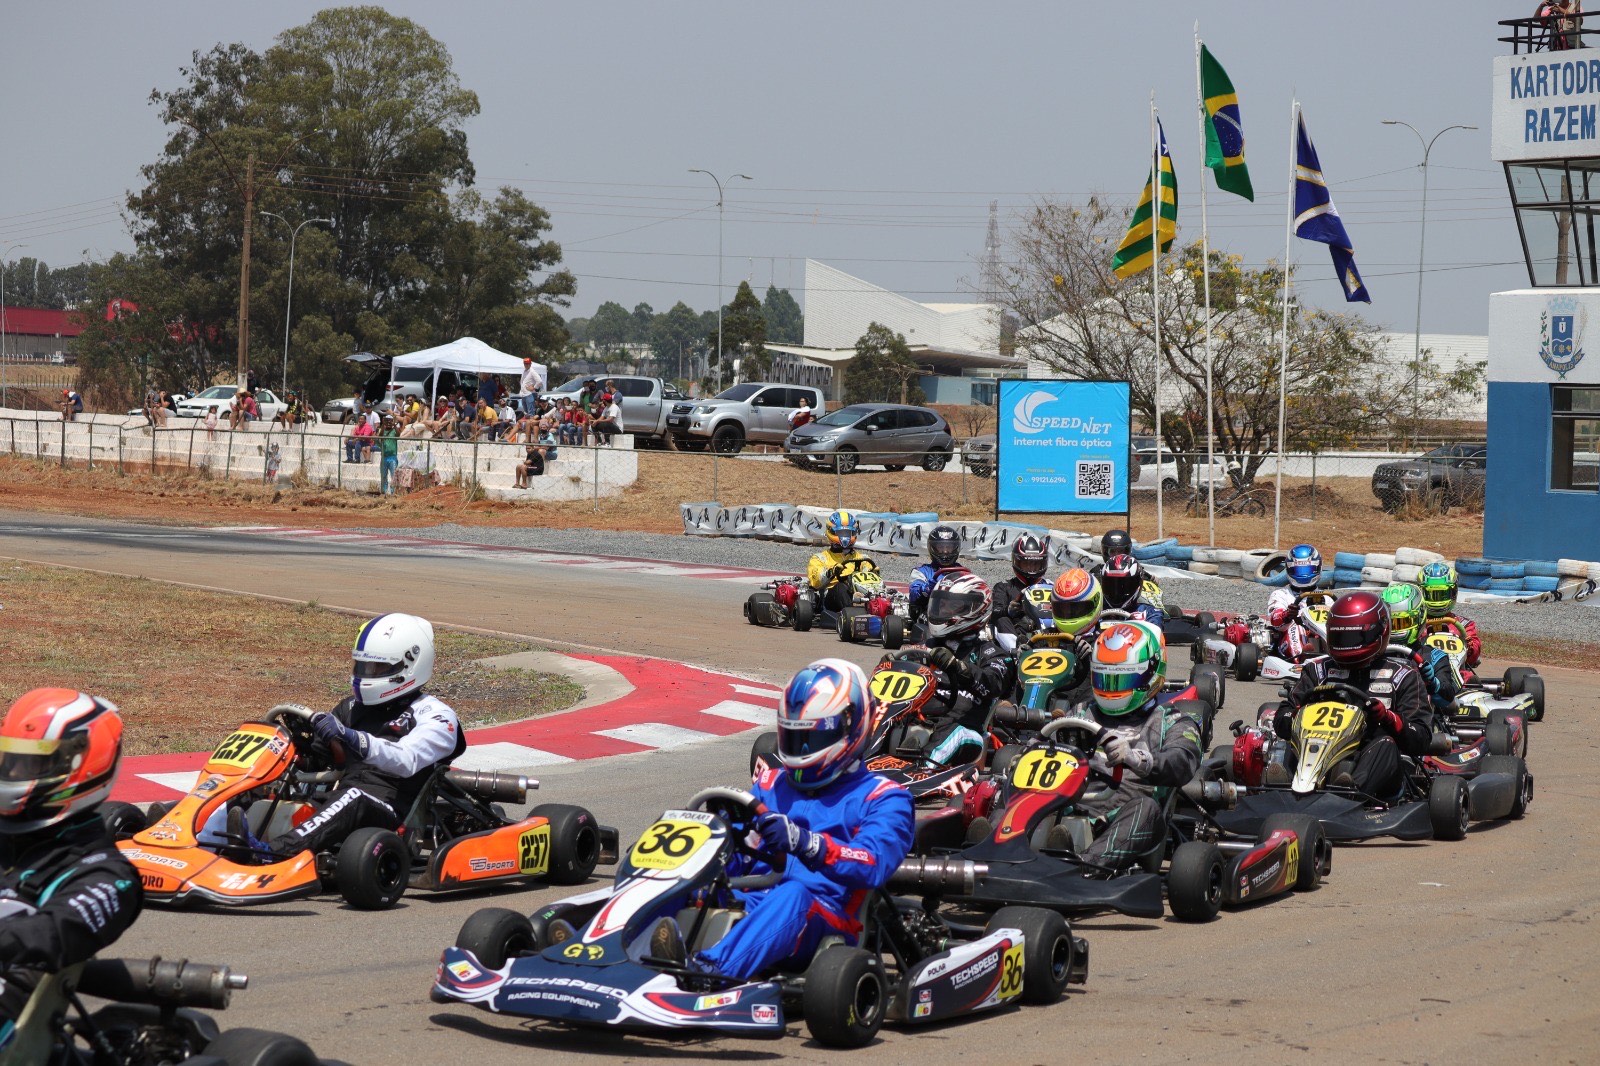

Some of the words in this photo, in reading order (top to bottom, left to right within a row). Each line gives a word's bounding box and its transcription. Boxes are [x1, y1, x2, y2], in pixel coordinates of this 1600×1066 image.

[1525, 105, 1596, 143] RAZEM
[1031, 416, 1082, 429] SPEED
[1013, 437, 1053, 447] internet
[1055, 436, 1079, 447] fibra
[1080, 438, 1112, 450] óptica
[853, 572, 878, 583] 123
[1032, 589, 1052, 601] 97
[1313, 610, 1329, 621] 73
[1433, 639, 1458, 651] 96
[1024, 656, 1063, 671] 29
[879, 674, 911, 699] 10
[1312, 706, 1345, 728] 25
[211, 733, 270, 763] 237
[1026, 758, 1062, 788] 18
[295, 787, 362, 837] LEANDRO
[637, 823, 700, 858] 36
[521, 834, 549, 870] 237
[487, 860, 515, 870] SPORTS
[927, 963, 946, 977] POLAR
[950, 950, 1000, 987] TECHSPEED
[1000, 951, 1022, 994] 36
[505, 977, 629, 999] TECHSPEED
[508, 992, 541, 1001] RACING
[541, 992, 602, 1010] EQUIPMENT
